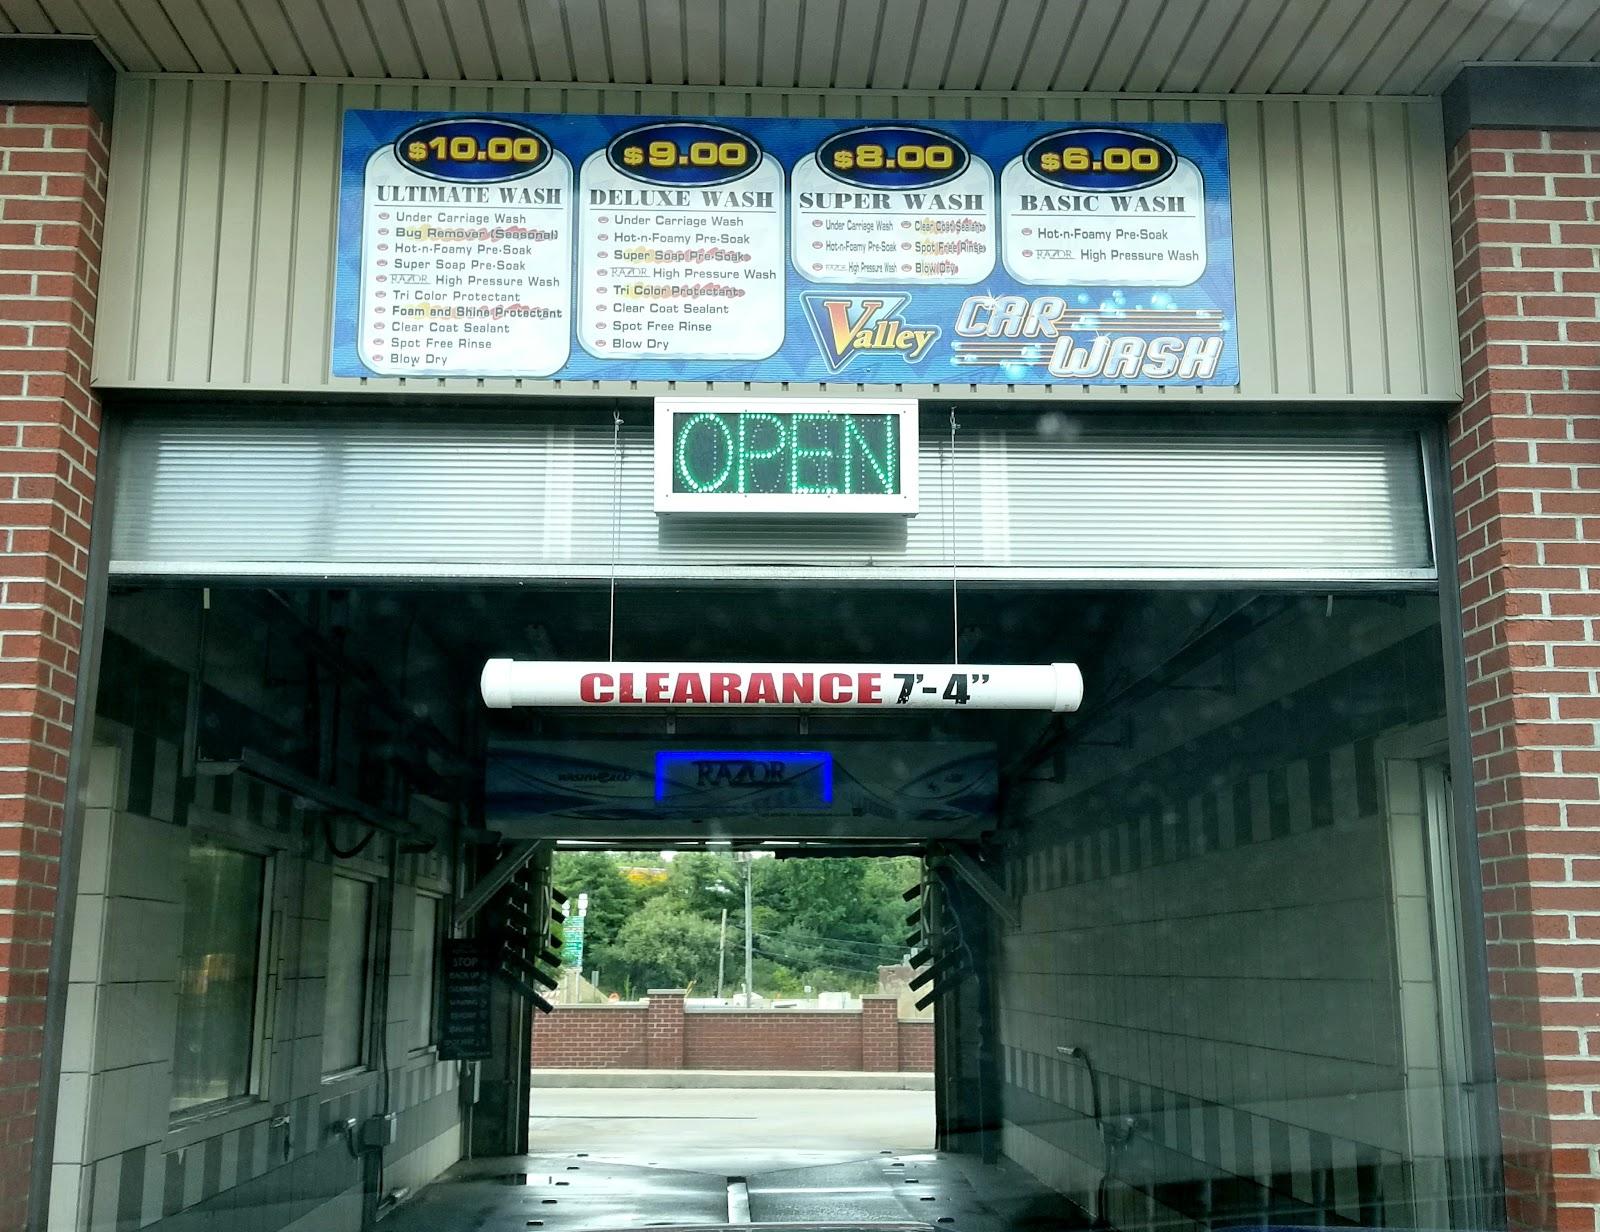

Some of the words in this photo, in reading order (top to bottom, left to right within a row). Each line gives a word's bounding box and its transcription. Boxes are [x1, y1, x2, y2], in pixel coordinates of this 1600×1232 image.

[408, 135, 541, 163] $10.00
[623, 141, 747, 167] $9.00
[833, 144, 954, 170] $8.00
[1040, 147, 1160, 172] $6.00
[376, 185, 489, 204] ULTIMATE
[498, 187, 563, 205] WASH
[589, 188, 690, 207] DELUXE
[702, 190, 774, 208] WASH
[799, 191, 891, 210] SUPER
[903, 193, 985, 211] WASH
[1018, 194, 1100, 212] BASIC
[1110, 195, 1187, 213] WASH
[395, 212, 432, 223] Under
[437, 213, 490, 225] Carriage
[494, 213, 527, 224] Wash
[614, 214, 651, 226] Under
[655, 215, 707, 228] Carriage
[711, 216, 744, 227] Wash
[825, 219, 845, 230] Under
[846, 219, 874, 233] Carriage
[876, 220, 894, 231] Wash
[914, 220, 934, 232] Clear
[936, 220, 954, 232] Coat
[956, 220, 985, 232] Sealant
[395, 227, 422, 240] Bug
[427, 228, 485, 239] Remover
[490, 229, 559, 240] (Seasonal)
[695, 233, 751, 245] Pre-Soak
[1115, 228, 1169, 241] Pre-Soak
[477, 244, 533, 255] Pre-Soak
[868, 240, 897, 252] Pre-Soak
[915, 241, 936, 254] Spot
[938, 241, 958, 253] Free
[960, 241, 984, 253] Rinse
[613, 250, 650, 263] Super
[655, 250, 685, 263] Soap
[690, 251, 744, 262] Pre-Soak
[1034, 249, 1076, 260] RAZOR
[1080, 250, 1107, 262] High
[1111, 250, 1164, 262] Pressure
[1168, 251, 1200, 261] Wash
[394, 258, 431, 271] Super
[435, 259, 466, 271] Soap
[471, 260, 526, 271] Pre-Soak
[849, 262, 860, 275] High
[861, 262, 883, 273] Pressure
[884, 262, 898, 273] Wash
[915, 261, 936, 274] Blow
[939, 261, 957, 275] Dry
[610, 266, 651, 278] RAZOR
[653, 267, 680, 280] High
[684, 268, 740, 279] Pressure
[744, 268, 777, 279] Wash
[389, 273, 431, 285] RAZOR
[435, 275, 463, 287] High
[468, 276, 523, 287] Pressure
[528, 277, 560, 287] Wash
[393, 290, 410, 301] Tri
[414, 290, 448, 301] Color
[453, 291, 520, 302] Protectant
[613, 284, 630, 296] Tri
[634, 285, 667, 296] Color
[671, 285, 739, 297] Protectant
[392, 305, 425, 317] Foam
[429, 306, 452, 317] and
[456, 306, 490, 318] Shine
[495, 307, 563, 319] Protectant
[612, 302, 645, 314] Clear
[649, 303, 679, 314] Coat
[683, 303, 729, 315] Sealant
[953, 294, 1067, 339] CAR
[391, 321, 424, 332] Clear
[429, 322, 459, 333] Coat
[464, 322, 510, 334] Sealant
[612, 320, 642, 333] Spot
[647, 321, 675, 332] Free
[679, 321, 712, 332] Rinse
[823, 300, 936, 357] Valley
[391, 337, 421, 350] Spot
[426, 338, 454, 349] Free
[458, 338, 492, 349] Rinse
[612, 338, 642, 349] Blow
[647, 339, 669, 351] Dry
[390, 353, 420, 365] Blow
[425, 354, 448, 366] Dry
[1047, 335, 1225, 380] WASH
[676, 413, 896, 494] OPEN
[579, 672, 882, 705] CLEARANCE
[691, 760, 792, 787] RAZOR
